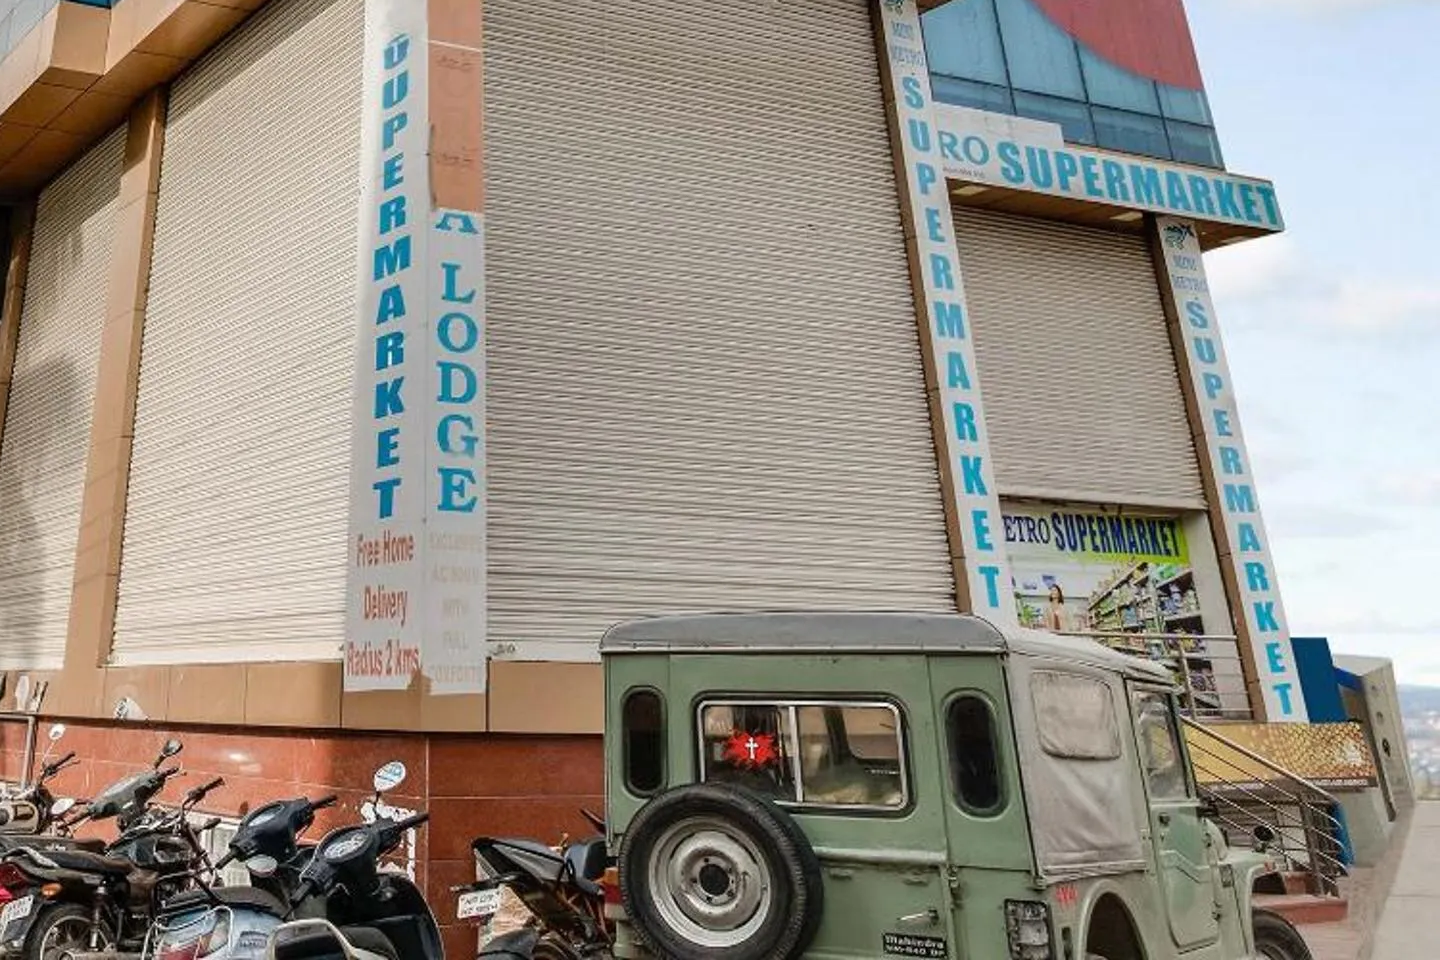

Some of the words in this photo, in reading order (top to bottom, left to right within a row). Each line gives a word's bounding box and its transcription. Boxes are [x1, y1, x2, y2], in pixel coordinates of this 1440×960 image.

[937, 131, 990, 166] RO
[997, 141, 1278, 226] SUPERMARKET
[902, 76, 999, 608] SUPERMARKET
[437, 262, 479, 512] LODGE
[1003, 515, 1051, 545] ETRO
[1052, 512, 1182, 558] SUPERMARKET
[1186, 301, 1293, 715] SUPERMARKET
[357, 534, 380, 567] Free
[383, 529, 414, 564] Home
[364, 585, 408, 627] Delivery
[347, 641, 383, 678] Radius
[385, 640, 393, 675] 2
[395, 640, 419, 675] kms
